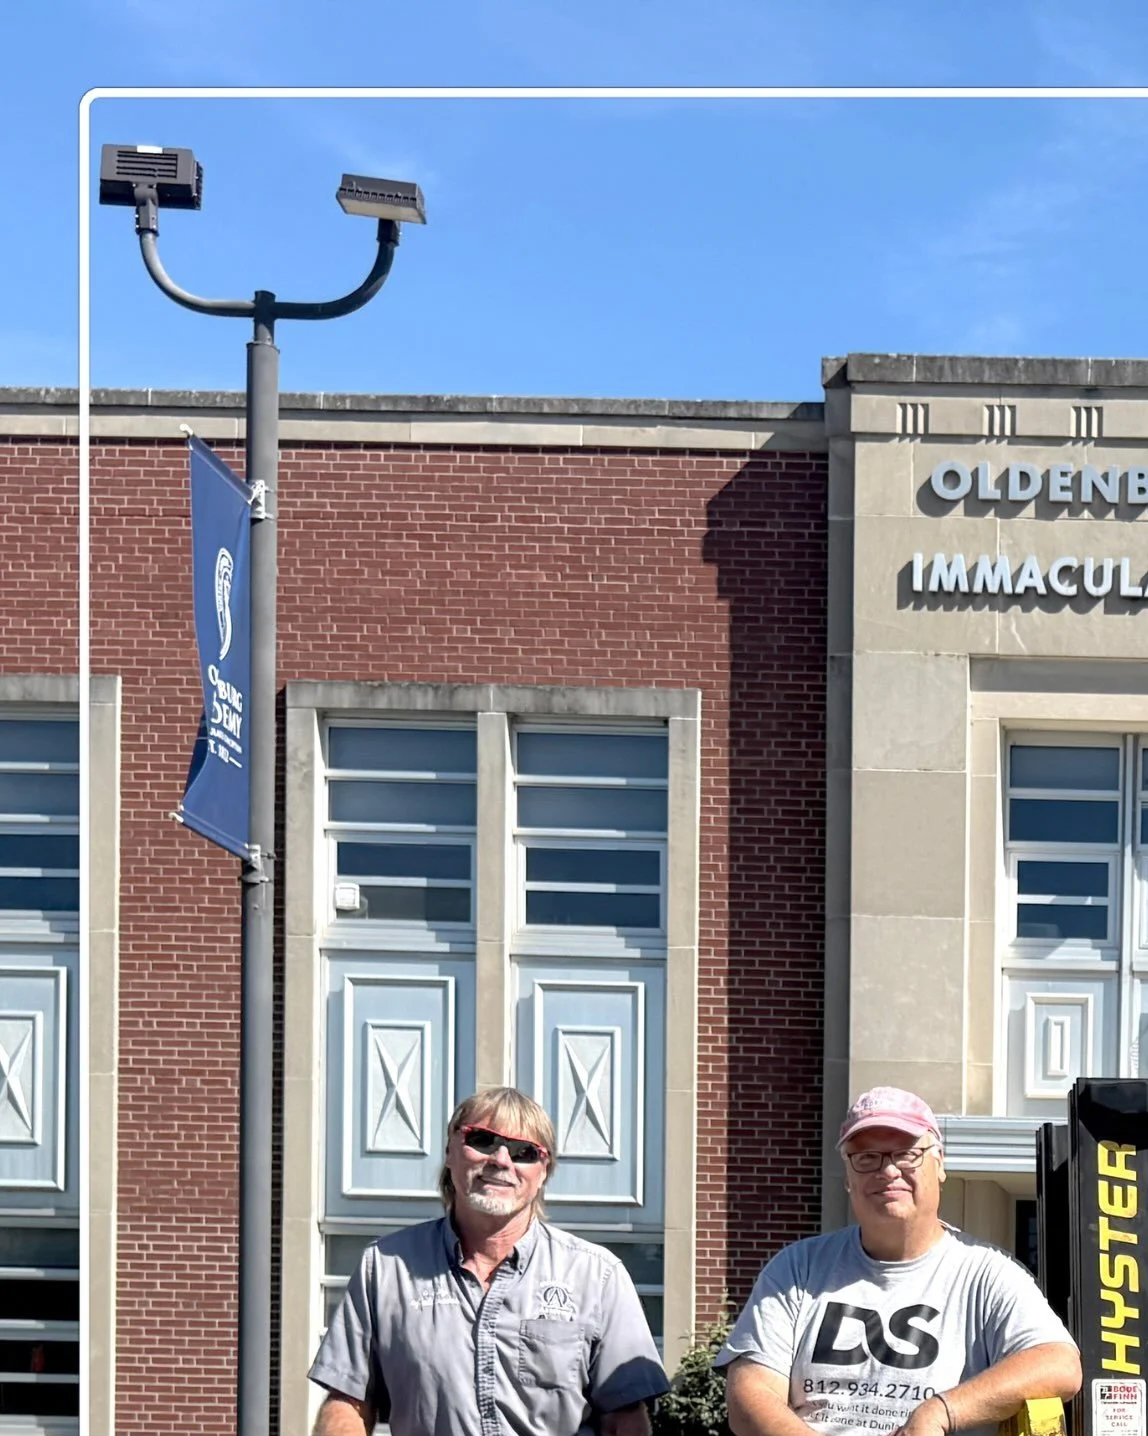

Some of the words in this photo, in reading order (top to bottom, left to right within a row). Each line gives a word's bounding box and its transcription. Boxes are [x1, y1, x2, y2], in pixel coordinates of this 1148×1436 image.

[1097, 1139, 1141, 1376] HYSTER
[811, 1301, 940, 1370] DS
[803, 1378, 936, 1401] 812.934.2710
[871, 1406, 898, 1418] done
